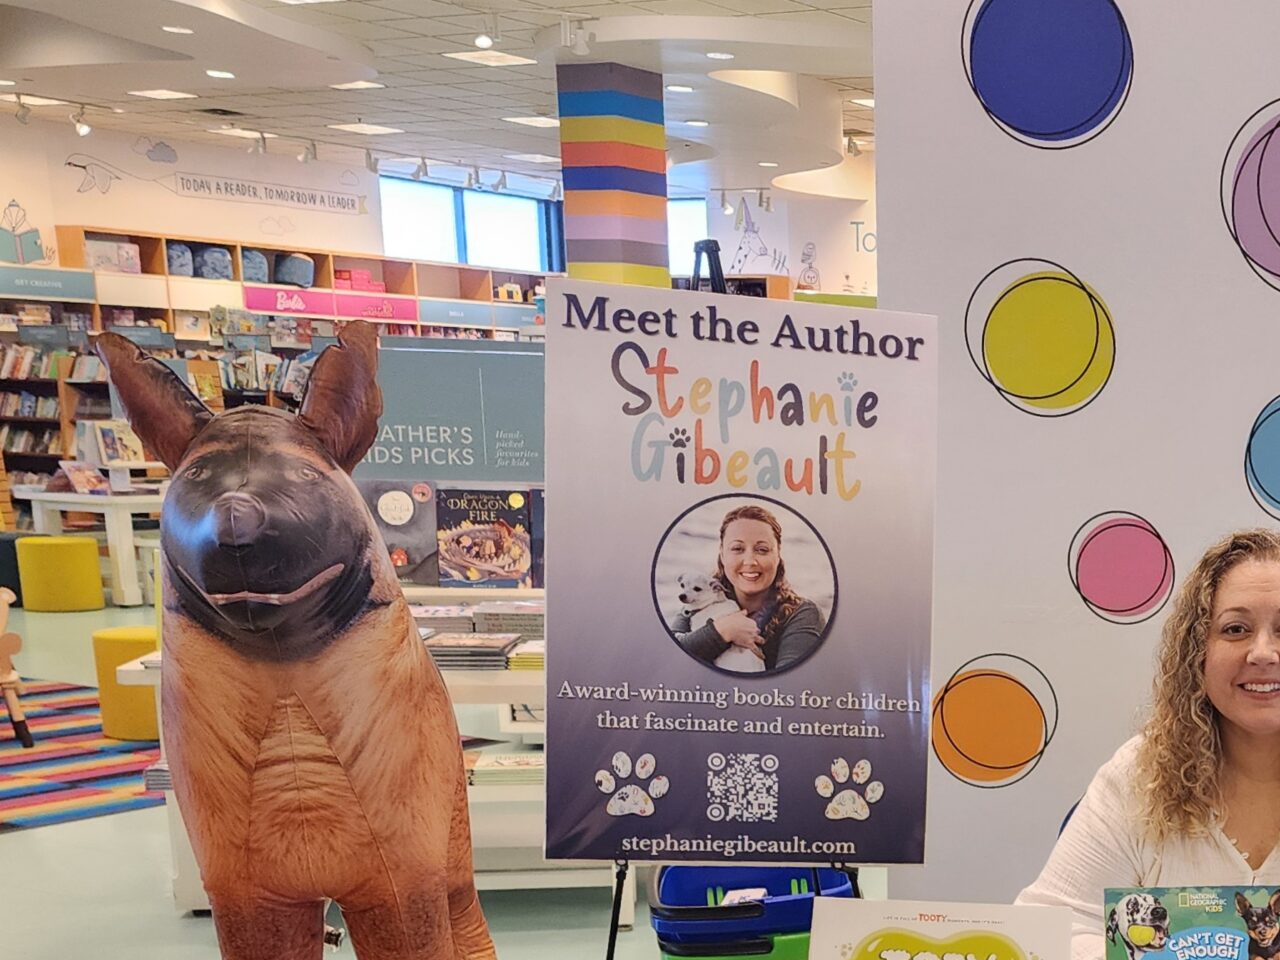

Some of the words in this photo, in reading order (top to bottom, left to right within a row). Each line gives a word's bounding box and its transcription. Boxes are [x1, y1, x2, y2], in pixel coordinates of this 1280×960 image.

[180, 178, 212, 194] TODAY
[216, 183, 222, 193] A
[224, 183, 262, 199] READER,
[264, 187, 317, 205] TOMORROW
[319, 195, 326, 206] A
[327, 195, 357, 210] LEADER
[276, 291, 306, 311] Barbie
[562, 293, 678, 338] Meet
[690, 305, 760, 345] the
[771, 314, 924, 361] Author
[610, 341, 879, 444] Stephanie
[376, 425, 473, 443] ATHER'S
[496, 440, 524, 449] picked
[411, 447, 474, 466] PICKS
[496, 458, 510, 468] for
[630, 412, 861, 501] Gibeault
[469, 511, 497, 521] FIRE
[557, 681, 728, 708] Award-winning
[733, 688, 795, 708] books
[800, 691, 832, 709] for
[836, 693, 921, 712] children
[597, 712, 639, 730] that
[644, 713, 739, 734] fascinate
[743, 717, 783, 735] and
[788, 721, 885, 738] entertain.
[622, 834, 856, 857] stephaniegibeault.com
[919, 913, 947, 922] TOOTY
[1168, 932, 1212, 951] CAN'T
[1215, 933, 1244, 948] GET
[1176, 945, 1239, 960] ENOUGH
